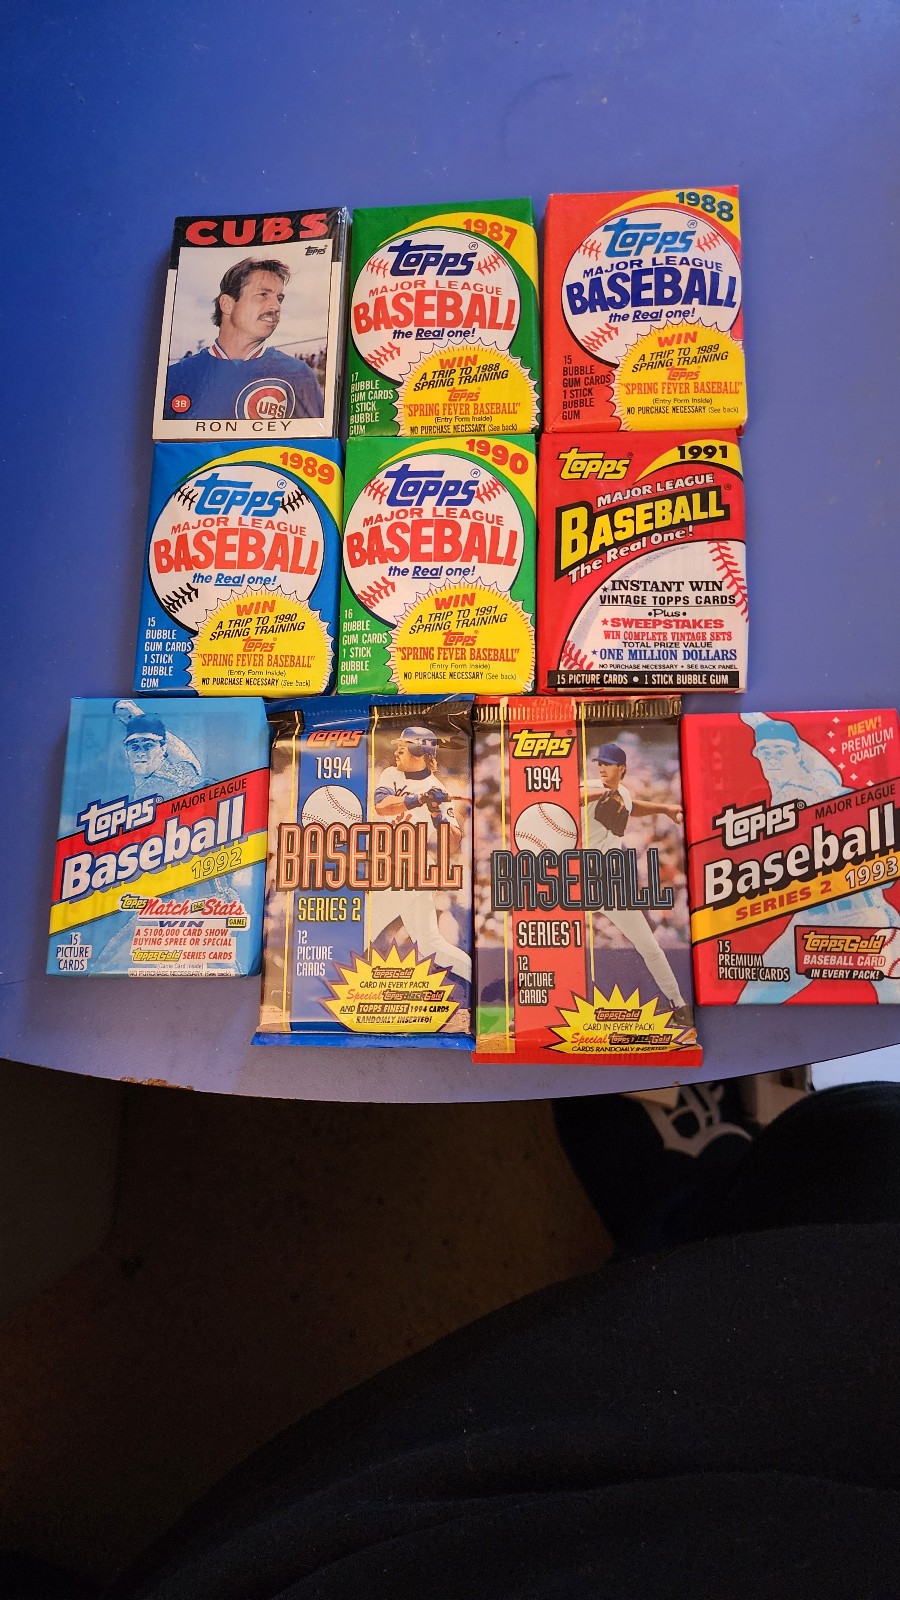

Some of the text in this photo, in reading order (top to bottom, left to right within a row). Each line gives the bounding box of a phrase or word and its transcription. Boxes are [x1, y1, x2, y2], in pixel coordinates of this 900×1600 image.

[676, 191, 734, 222] 1988
[186, 214, 329, 245] CUBS
[463, 219, 518, 249] 1987
[583, 256, 723, 278] MAJOR LEAGUE
[369, 279, 502, 297] MAJOR LEAGUE
[566, 267, 737, 315] BASEBALL
[354, 290, 517, 334] BASEBALL
[609, 308, 695, 323] the Real one!
[393, 328, 475, 341] the Real one!
[658, 331, 697, 348] WIN
[439, 354, 477, 369] WIN
[564, 355, 572, 364] 15
[420, 363, 500, 381] A TRIP TO 1988
[563, 365, 594, 375] BUBBLE
[413, 370, 509, 391] SPRING TRAINING
[563, 374, 611, 387] GUM CARDS
[570, 388, 593, 398] STICK
[175, 400, 187, 408] 3B
[563, 398, 594, 409] BUBBLE
[562, 410, 580, 420] GUM
[195, 421, 291, 432] RON CEY
[466, 439, 529, 475] 1990
[678, 445, 728, 460] 1991
[280, 452, 335, 484] 1989
[597, 472, 714, 508] MAJOR LEAGUE
[363, 507, 504, 528] MAJOR LEAGUE
[171, 517, 307, 536] MAJOR LEAGUE
[560, 490, 725, 571] BASEBALL
[346, 519, 517, 568] BASEBALL
[154, 528, 319, 575] BASEBALL
[567, 558, 603, 584] The
[606, 536, 646, 564] Real
[611, 580, 724, 592] INSTANT WIN
[600, 595, 736, 605] VINTAGE TOPPS CARDS
[236, 600, 276, 616] WIN
[345, 609, 352, 618] 16
[216, 613, 297, 630] A TRIP TO 1990
[343, 620, 370, 631] BUBBLE
[611, 618, 724, 629] SWEEPSTAKES
[210, 621, 305, 641] SPRING TRAINING
[343, 633, 388, 644] GUM CARDS
[604, 631, 732, 641] WIN COMPLETE VINTAGE SETS
[350, 647, 371, 657] STICK
[600, 649, 737, 661] ONE MILLION DOLLARS
[341, 661, 369, 671] BUBBLE
[341, 674, 357, 684] GUM
[557, 675, 566, 684] 15
[568, 674, 600, 684] PICTURE
[603, 674, 628, 684] CARDS
[652, 674, 673, 684] STICK
[677, 674, 707, 684] BUBBLE
[710, 674, 729, 684] GUM
[848, 716, 882, 737] NEW!
[841, 727, 894, 754] PREMIUM
[850, 743, 886, 764] QUALITY
[316, 757, 352, 779] 1994
[525, 767, 561, 791] 1994
[171, 778, 247, 814] MAJOR LEAGUE
[815, 784, 896, 819] MAJOR LEAGUE
[62, 793, 246, 900] Baseball
[705, 801, 895, 905] Baseball
[192, 847, 242, 879] 1992
[278, 823, 463, 890] BASEBALL
[492, 848, 674, 910] BASEBALL
[845, 857, 898, 888] 1993
[736, 880, 832, 921] SERIES 2
[298, 898, 361, 921] SERIES 2
[70, 934, 78, 945] 15
[144, 929, 180, 937] $100,000
[205, 929, 228, 937] SHOW
[297, 930, 308, 944] 12
[518, 921, 581, 946] SERIES 1
[133, 938, 162, 946] BUYING
[164, 938, 187, 946] SPREE
[203, 938, 232, 946] SPECIAL
[718, 941, 731, 952] 15
[56, 947, 89, 958] PICTURE
[297, 946, 333, 960] PICTURE
[719, 954, 763, 966] PREMIUM
[59, 959, 85, 970] CARDS
[518, 956, 528, 971] 12
[803, 955, 886, 966] BASEBALL CARD
[296, 962, 325, 976] CARDS
[719, 967, 790, 980] PICTURE CARDS
[811, 970, 879, 979] IN EVERY PACK!
[518, 973, 553, 987] PICTURE
[519, 990, 547, 1004] CARDS
